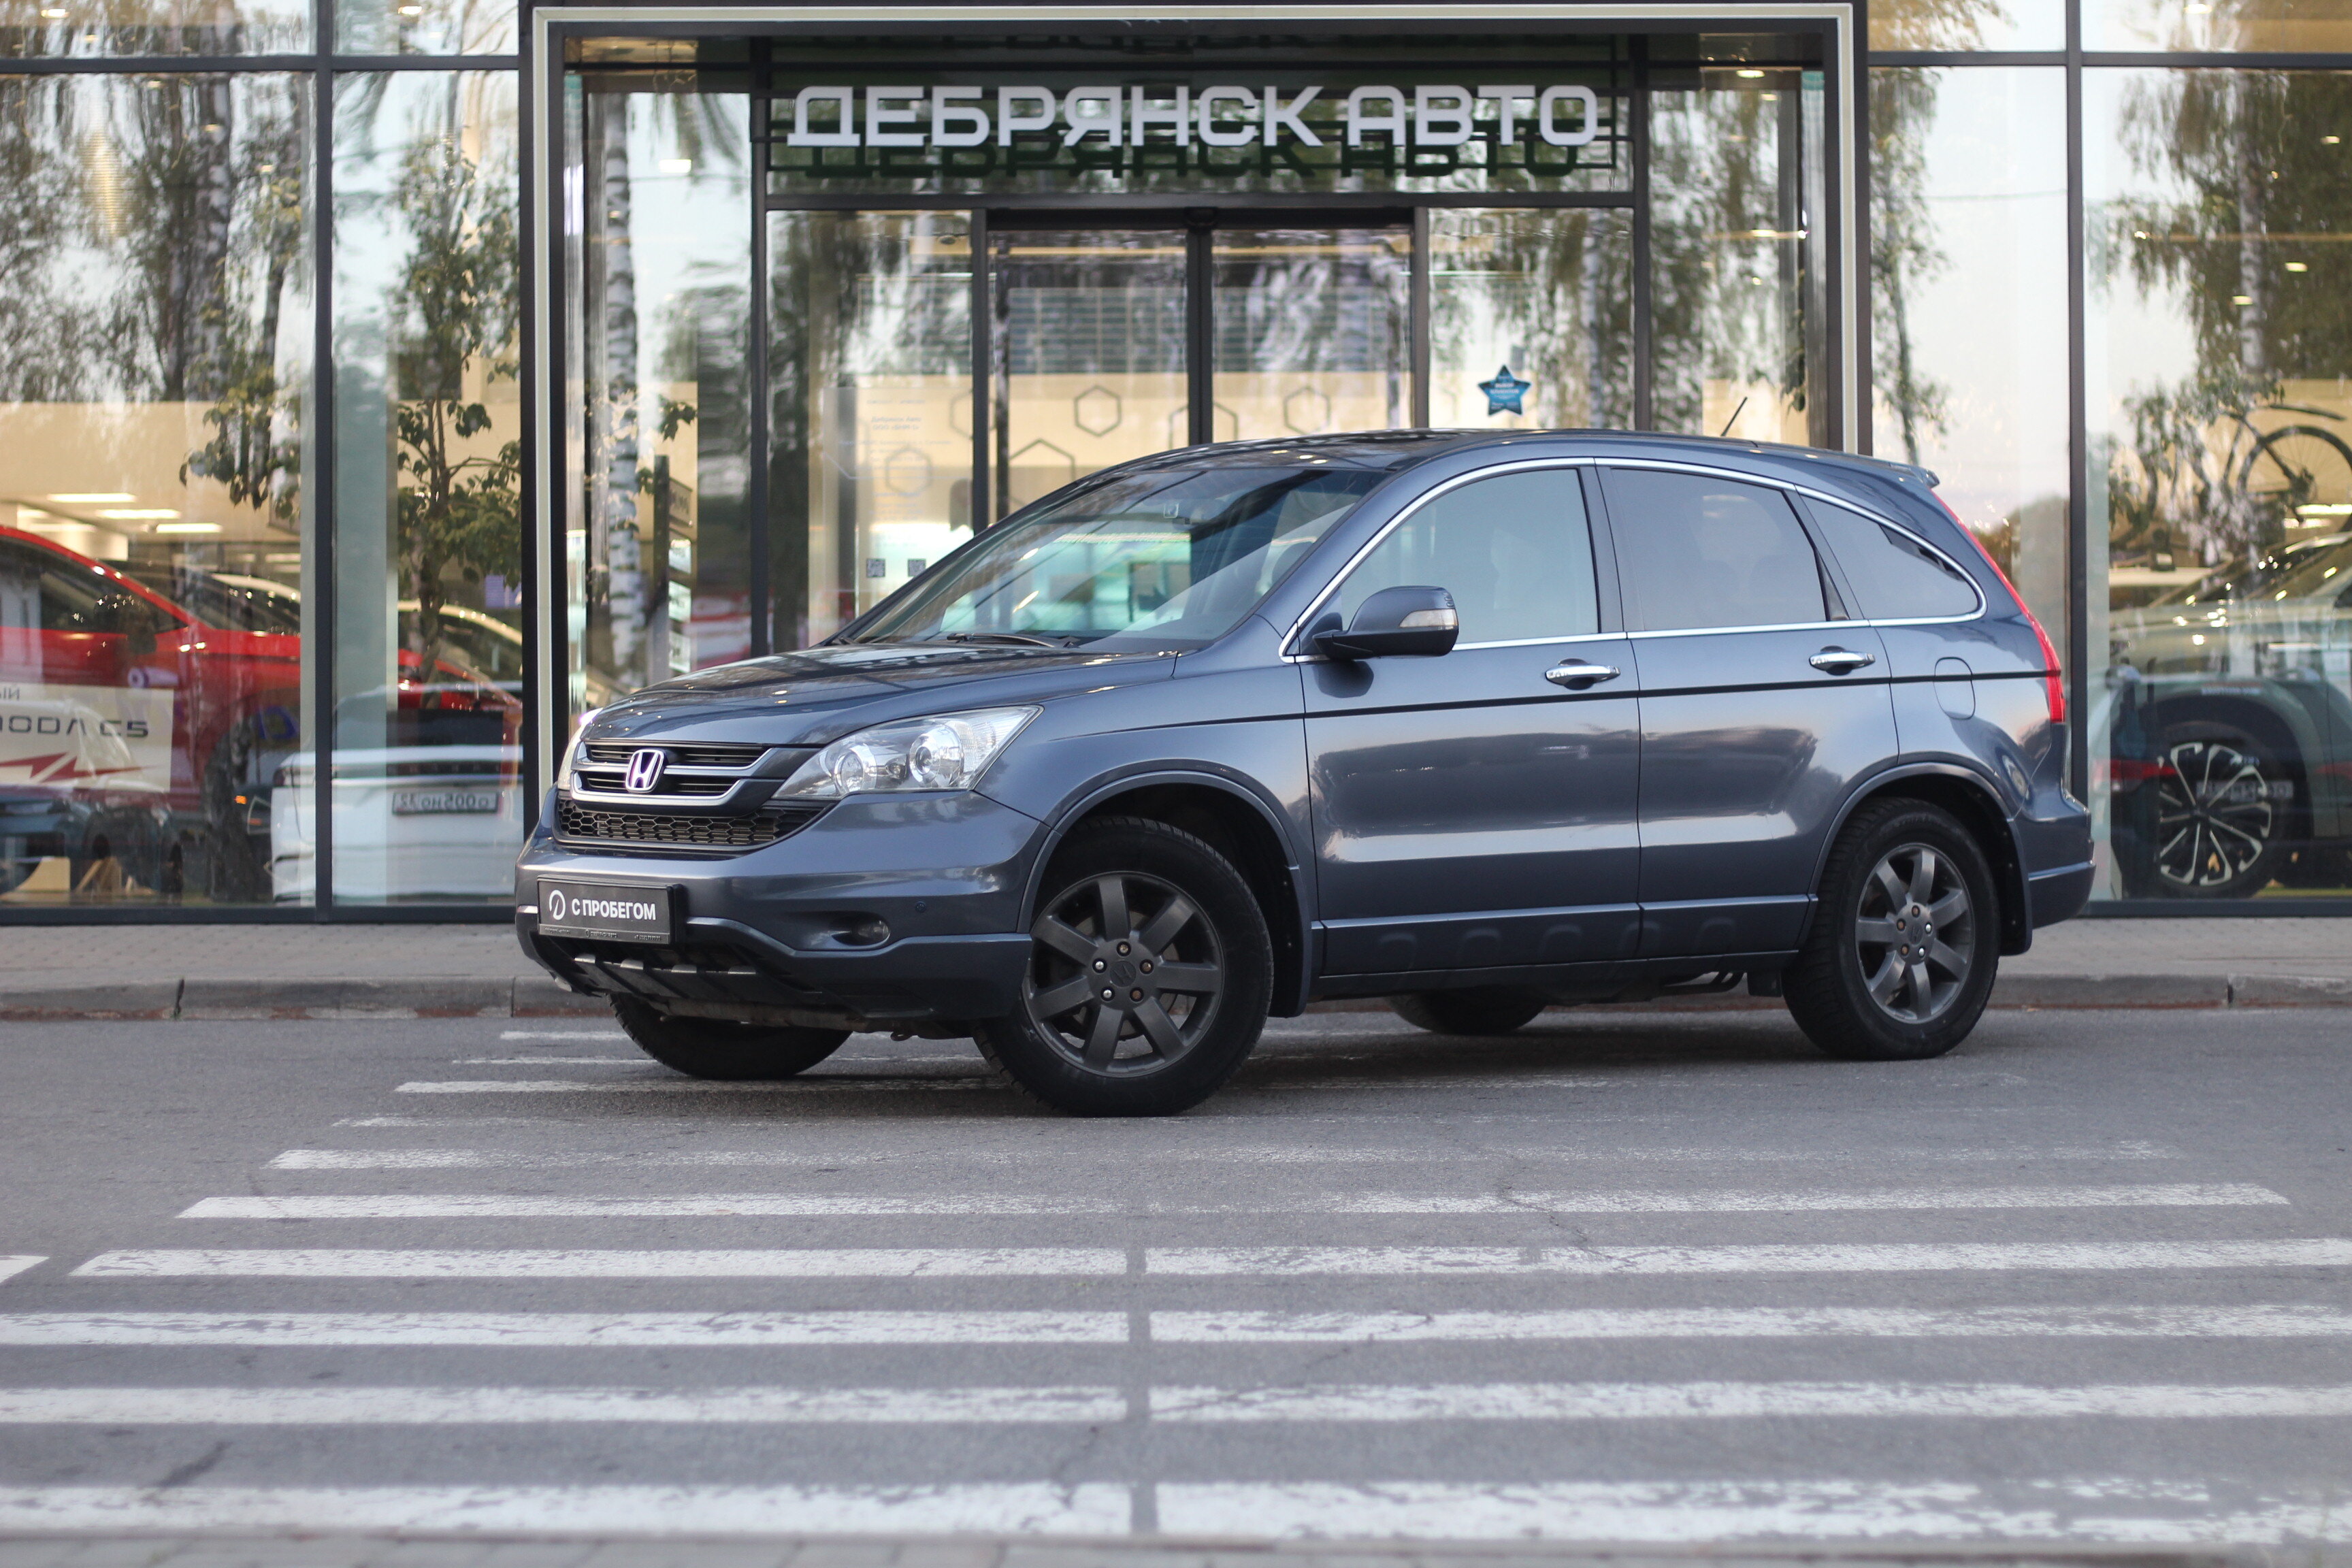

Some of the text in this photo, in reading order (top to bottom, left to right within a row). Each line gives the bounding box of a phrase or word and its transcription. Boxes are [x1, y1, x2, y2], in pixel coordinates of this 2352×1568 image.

[787, 85, 1597, 147] ДЕБРЯНСК АВТО
[571, 898, 656, 921] С ПРОБЕГОМ
